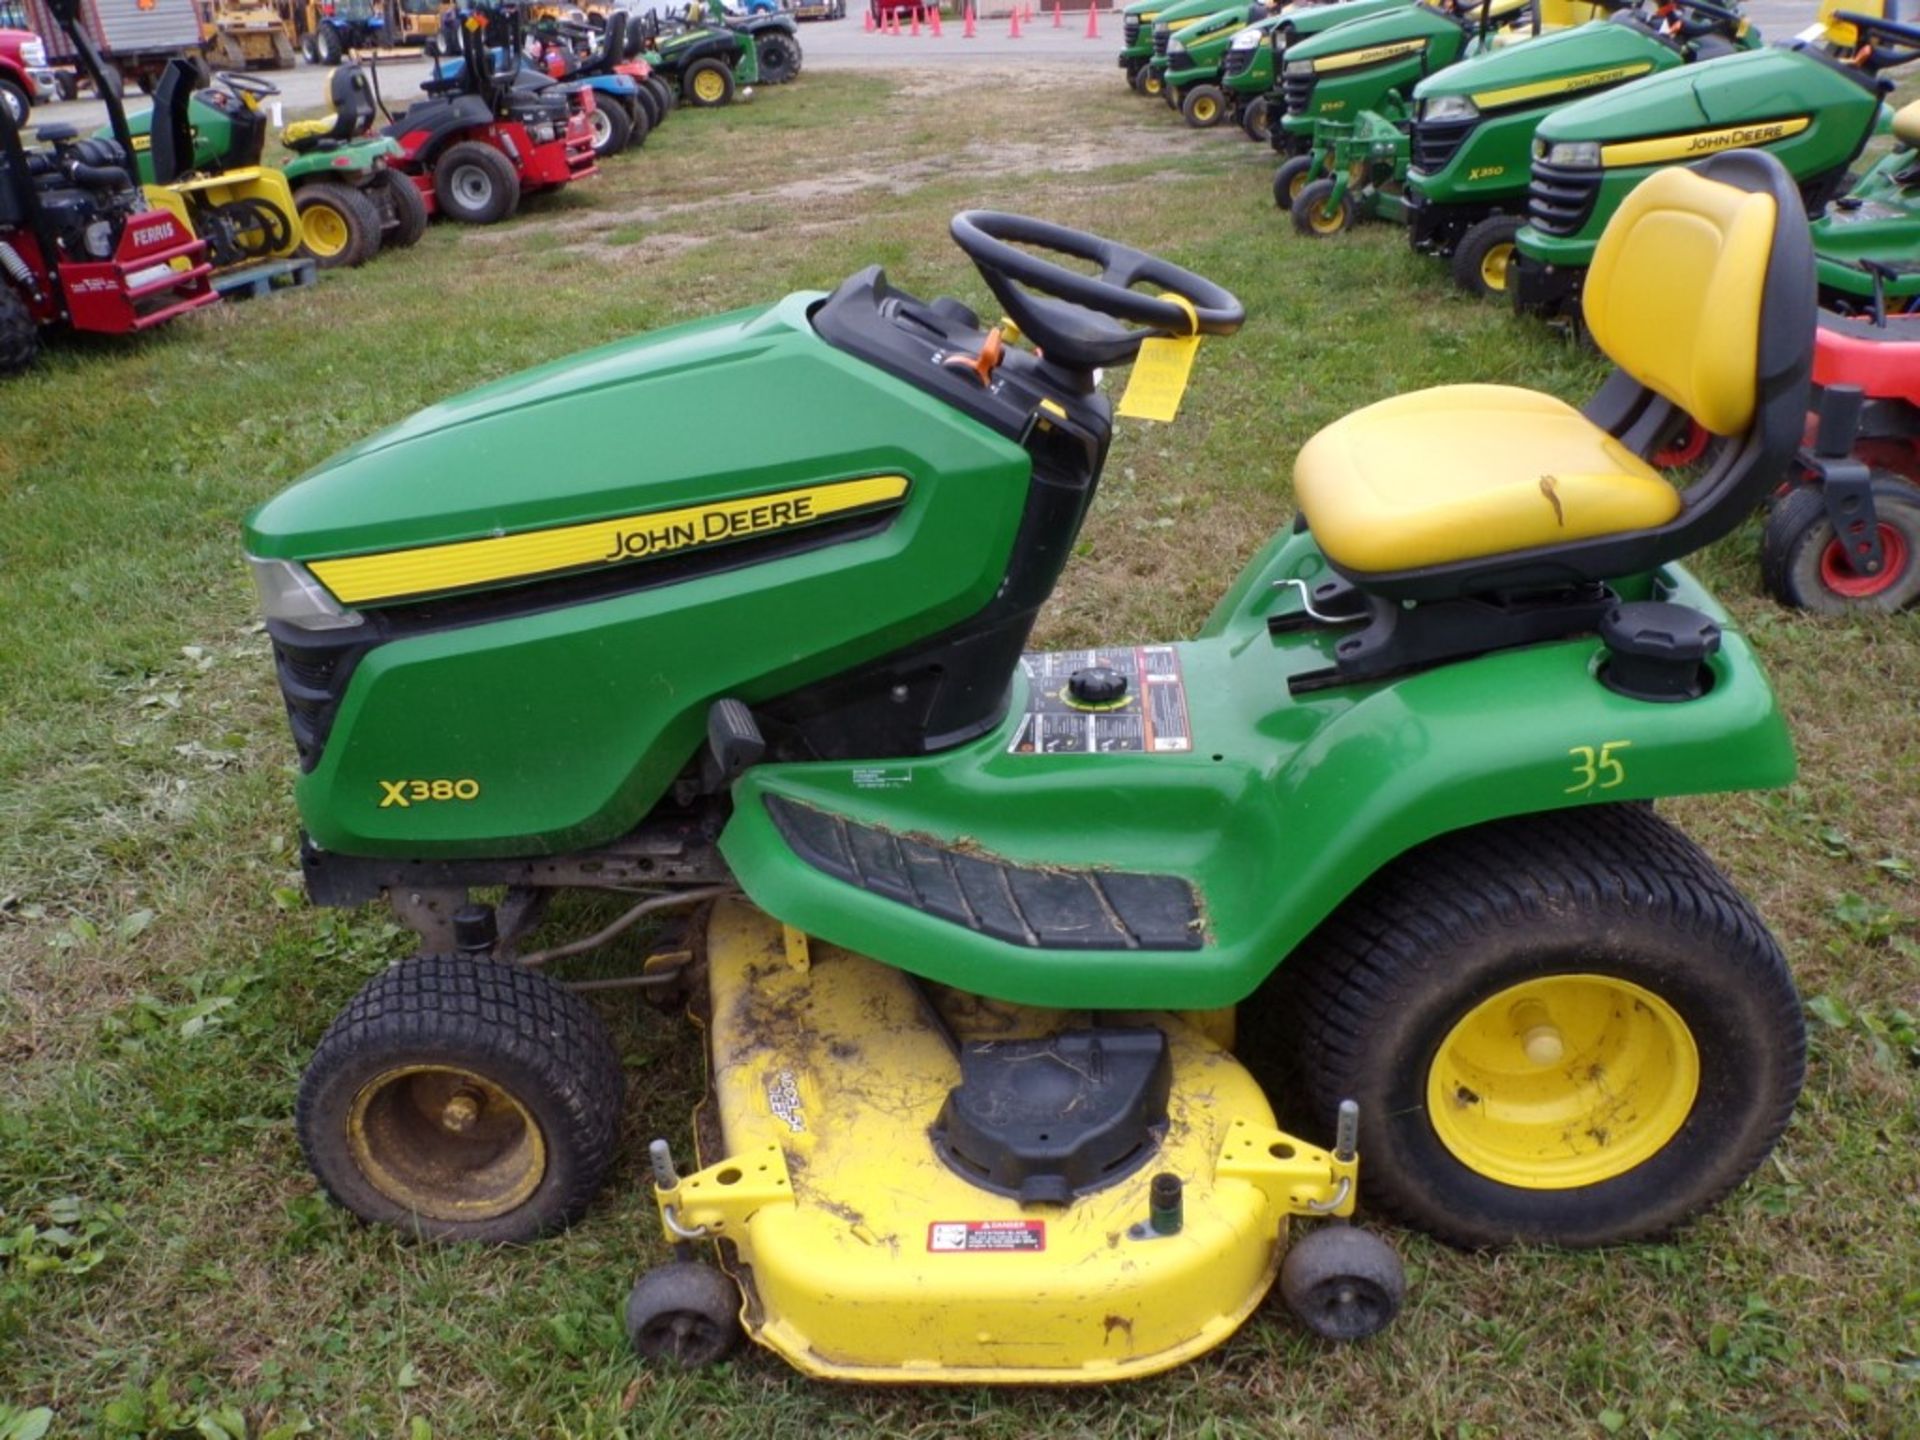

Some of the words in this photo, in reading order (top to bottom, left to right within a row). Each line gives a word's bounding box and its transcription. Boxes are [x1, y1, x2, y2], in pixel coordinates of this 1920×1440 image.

[1686, 134, 1730, 151] JOHN
[1731, 125, 1784, 145] DEERE
[1468, 166, 1504, 181] X350
[132, 222, 174, 247] FERRIS
[606, 522, 695, 559] JOHN
[703, 497, 813, 539] DEERE
[1564, 740, 1632, 794] 35
[379, 779, 480, 807] X380
